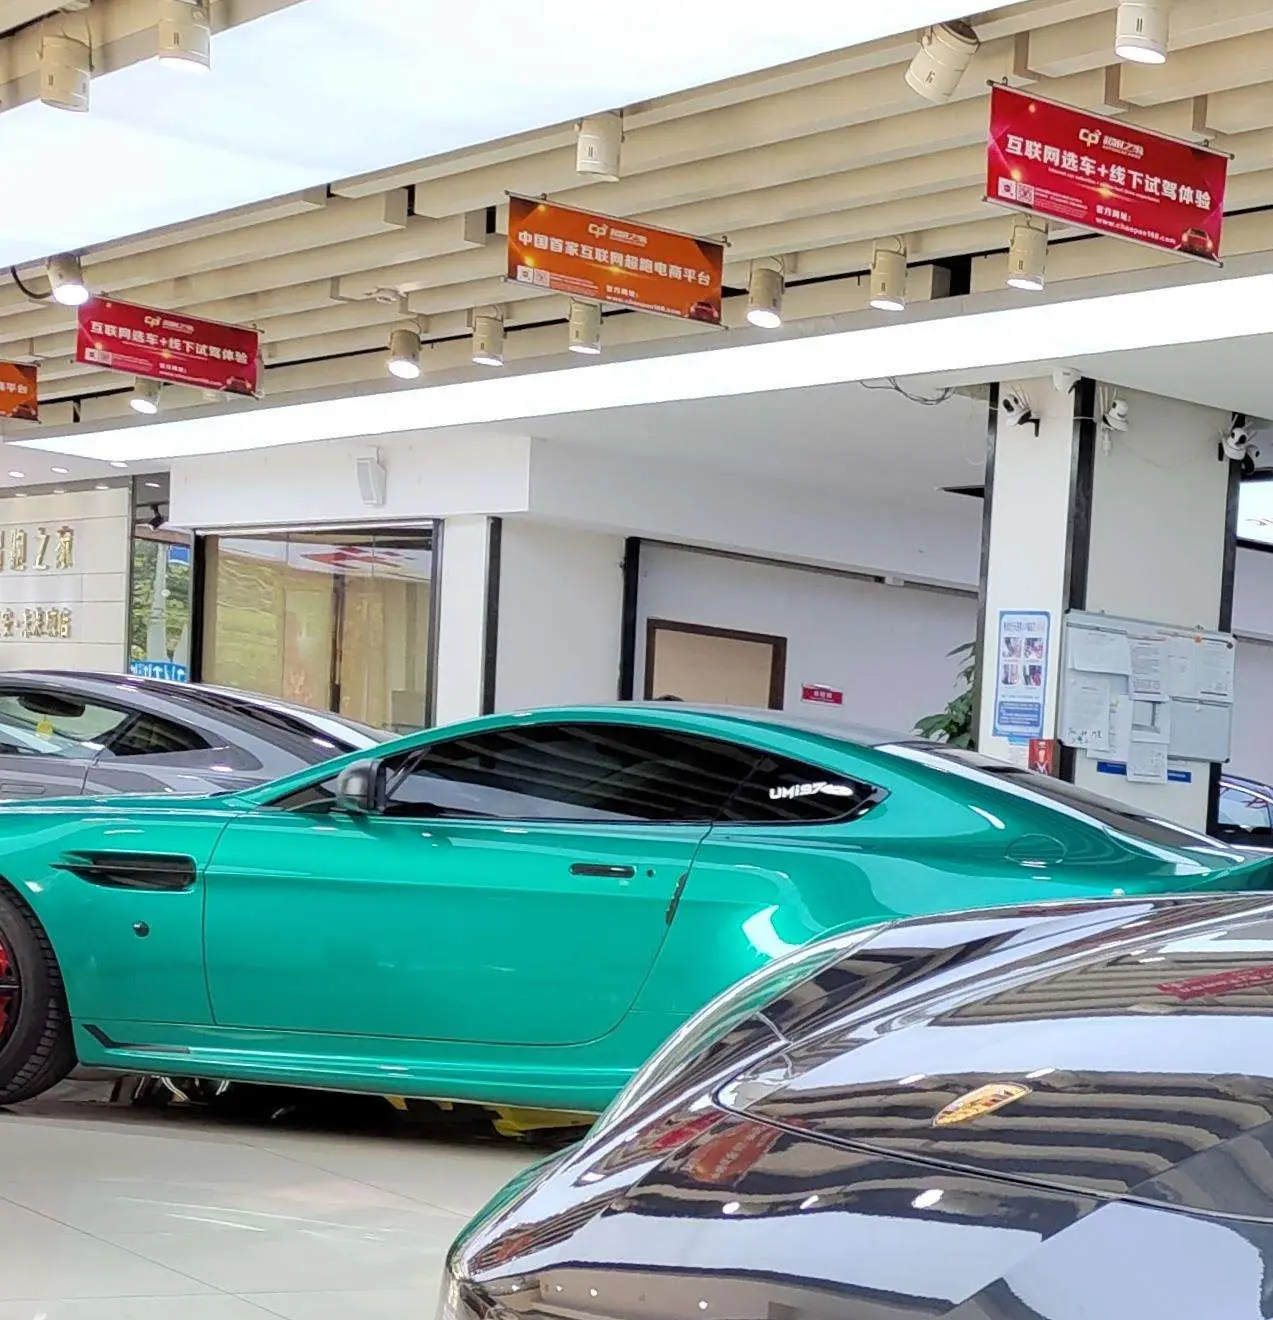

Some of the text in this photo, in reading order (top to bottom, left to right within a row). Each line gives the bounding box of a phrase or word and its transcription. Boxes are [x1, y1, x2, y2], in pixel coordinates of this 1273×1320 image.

[1005, 134, 1212, 211] 互联网选车+线下试驾体验
[518, 230, 711, 287] 中国首家互联网超跑电商平台
